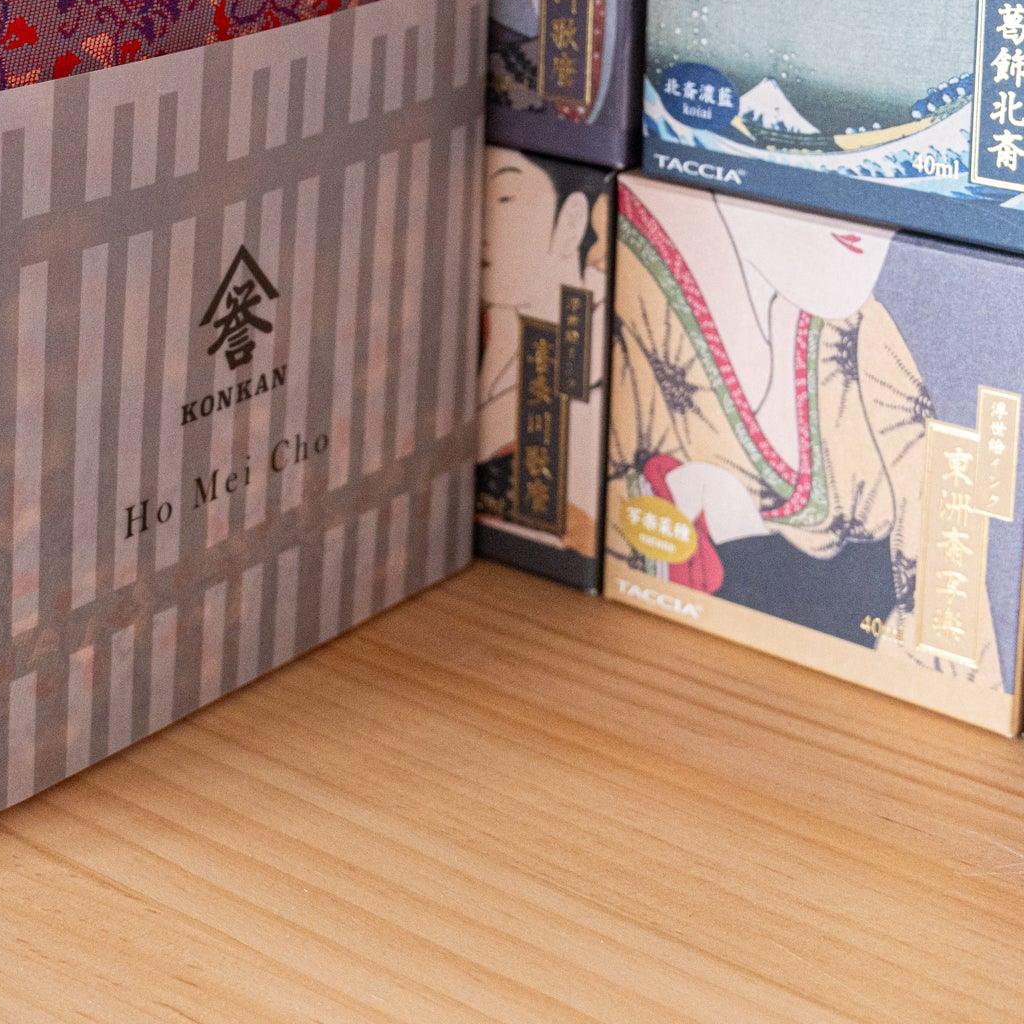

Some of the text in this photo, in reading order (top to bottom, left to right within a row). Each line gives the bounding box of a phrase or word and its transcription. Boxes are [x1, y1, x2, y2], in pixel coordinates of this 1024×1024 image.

[653, 153, 744, 185] TACCIA
[912, 153, 960, 180] 40ml
[180, 364, 289, 426] KONKAN
[125, 432, 331, 540] Ho Mei Cho
